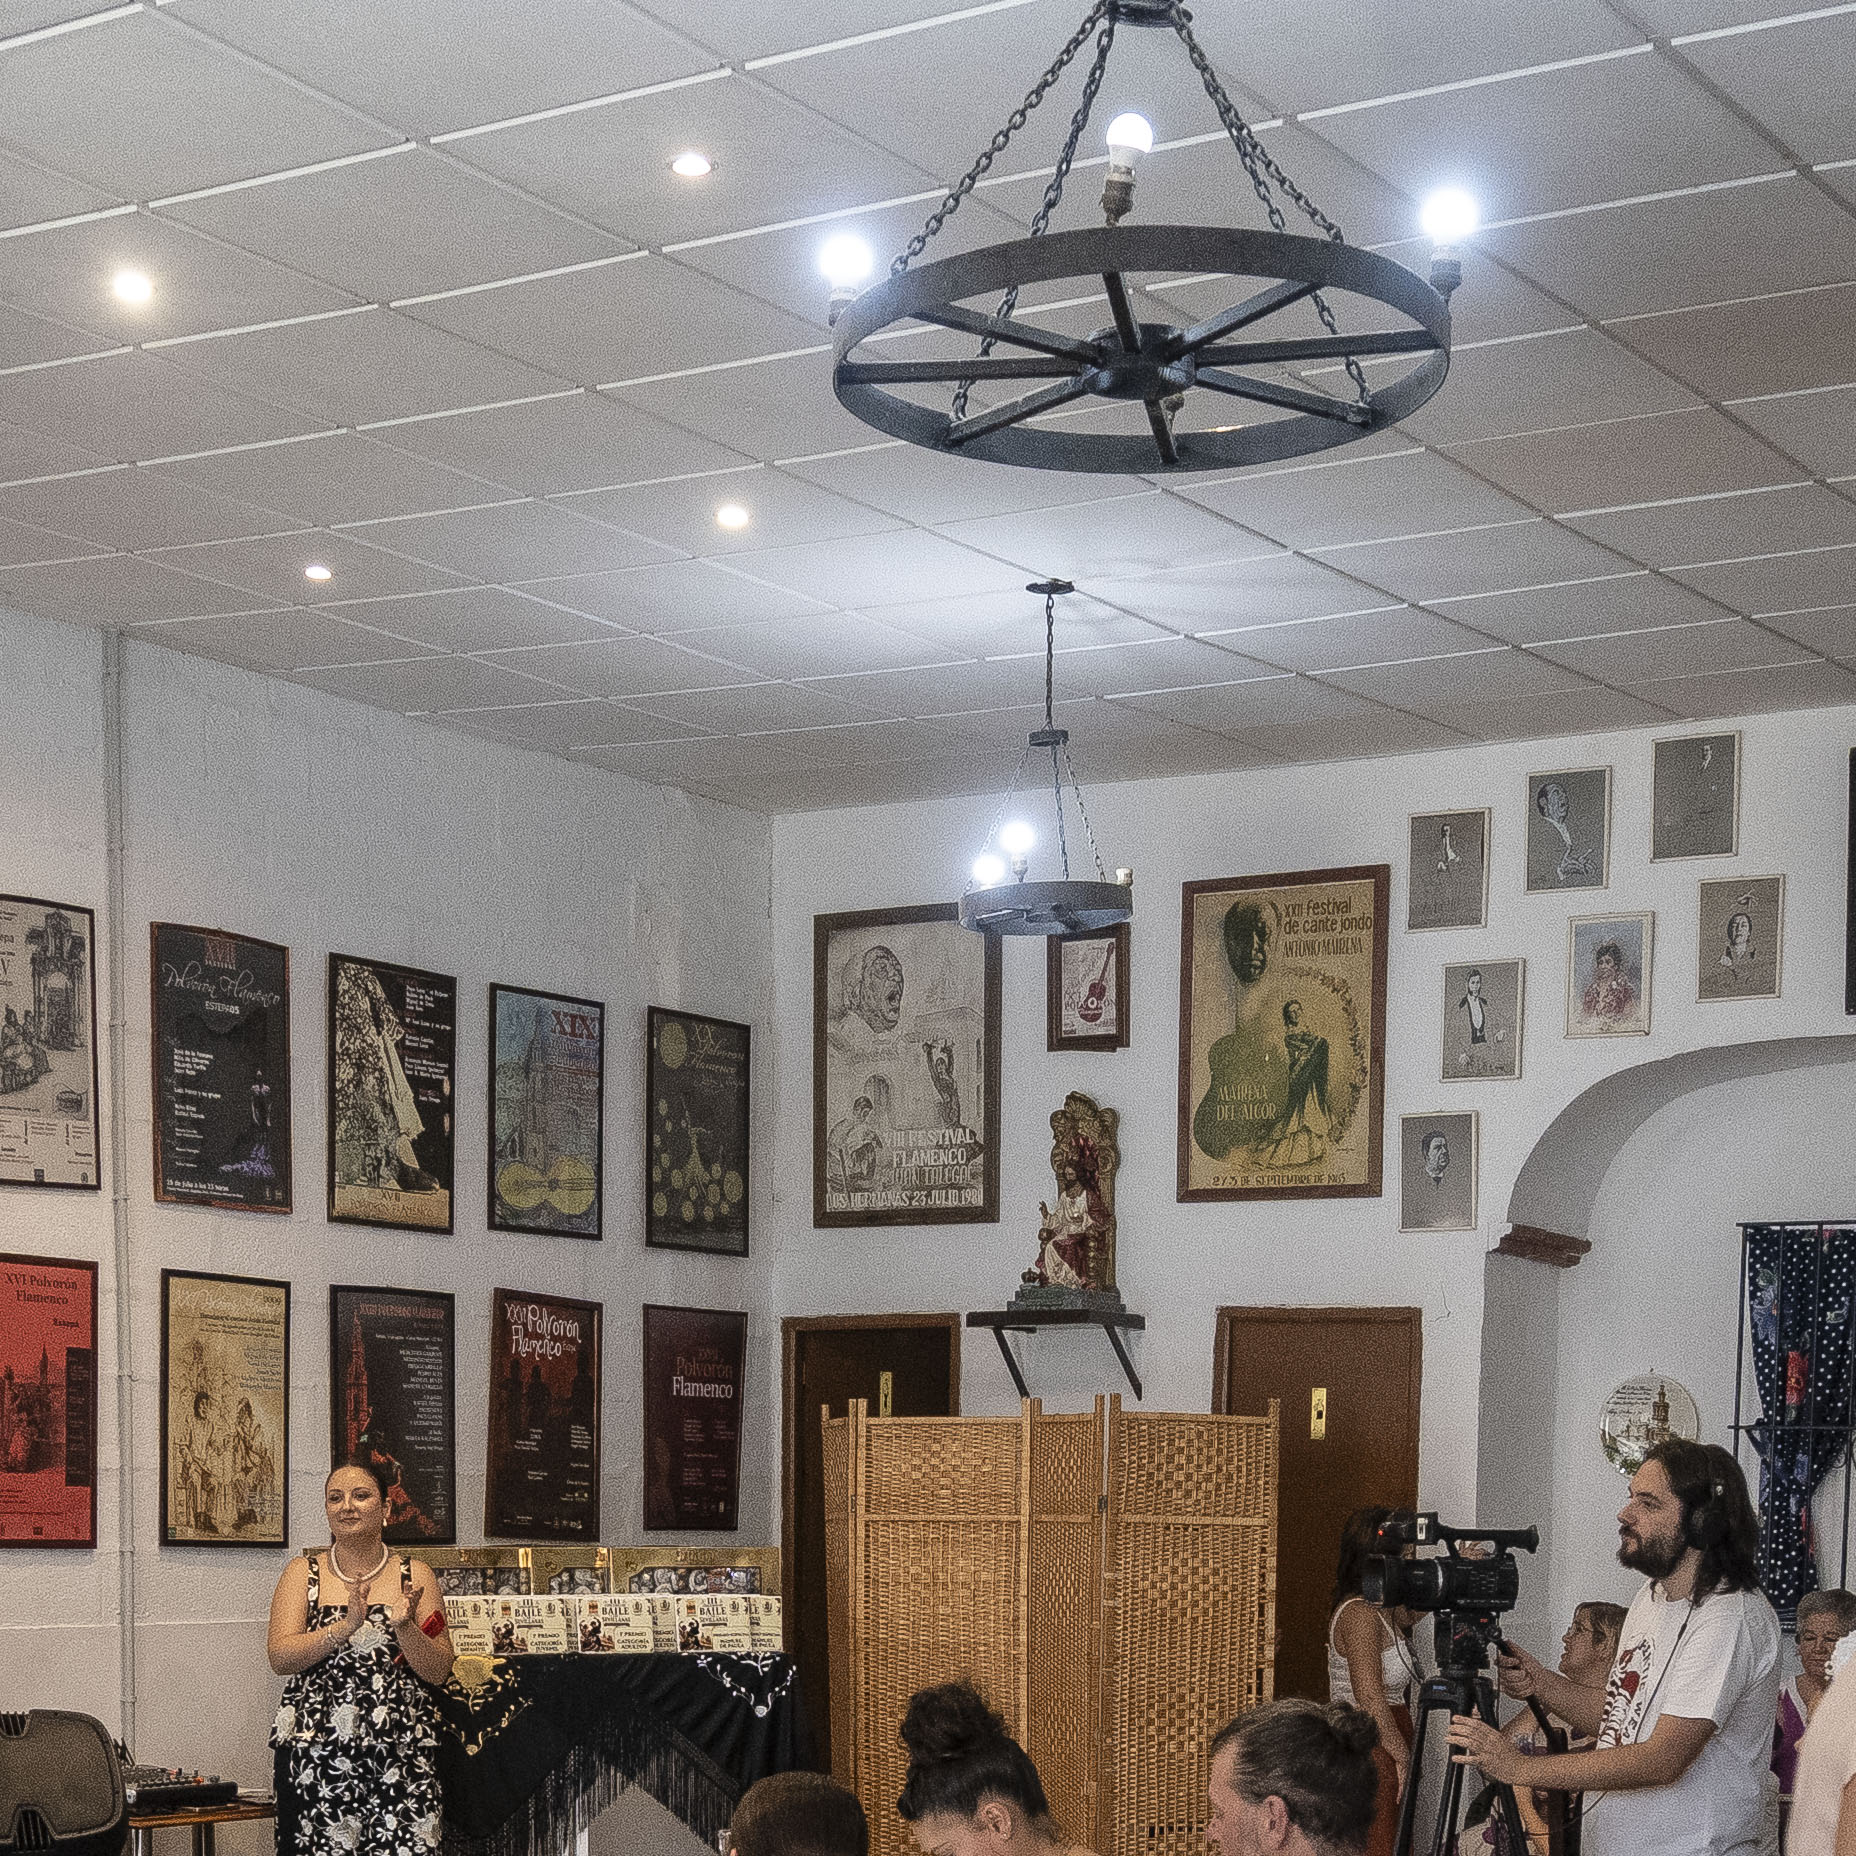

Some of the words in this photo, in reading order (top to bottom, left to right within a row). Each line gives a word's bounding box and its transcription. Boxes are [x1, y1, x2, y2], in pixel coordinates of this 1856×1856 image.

[1284, 917, 1300, 935] de
[1303, 914, 1338, 934] cante
[551, 1010, 597, 1041] XIX
[1217, 1104, 1241, 1121] DEL
[908, 1128, 975, 1147] FESTIVAL
[893, 1149, 967, 1167] FLAMENCO
[16, 1289, 69, 1305] Flamenco
[527, 1304, 582, 1343] Polvorón
[511, 1325, 562, 1361] Flamenco
[676, 1355, 734, 1379] Polvorón
[672, 1375, 733, 1399] Flamenco
[447, 1609, 468, 1618] AILE
[514, 1608, 543, 1618] BAILE
[601, 1607, 630, 1617] BAILE
[700, 1606, 727, 1616] BAILE
